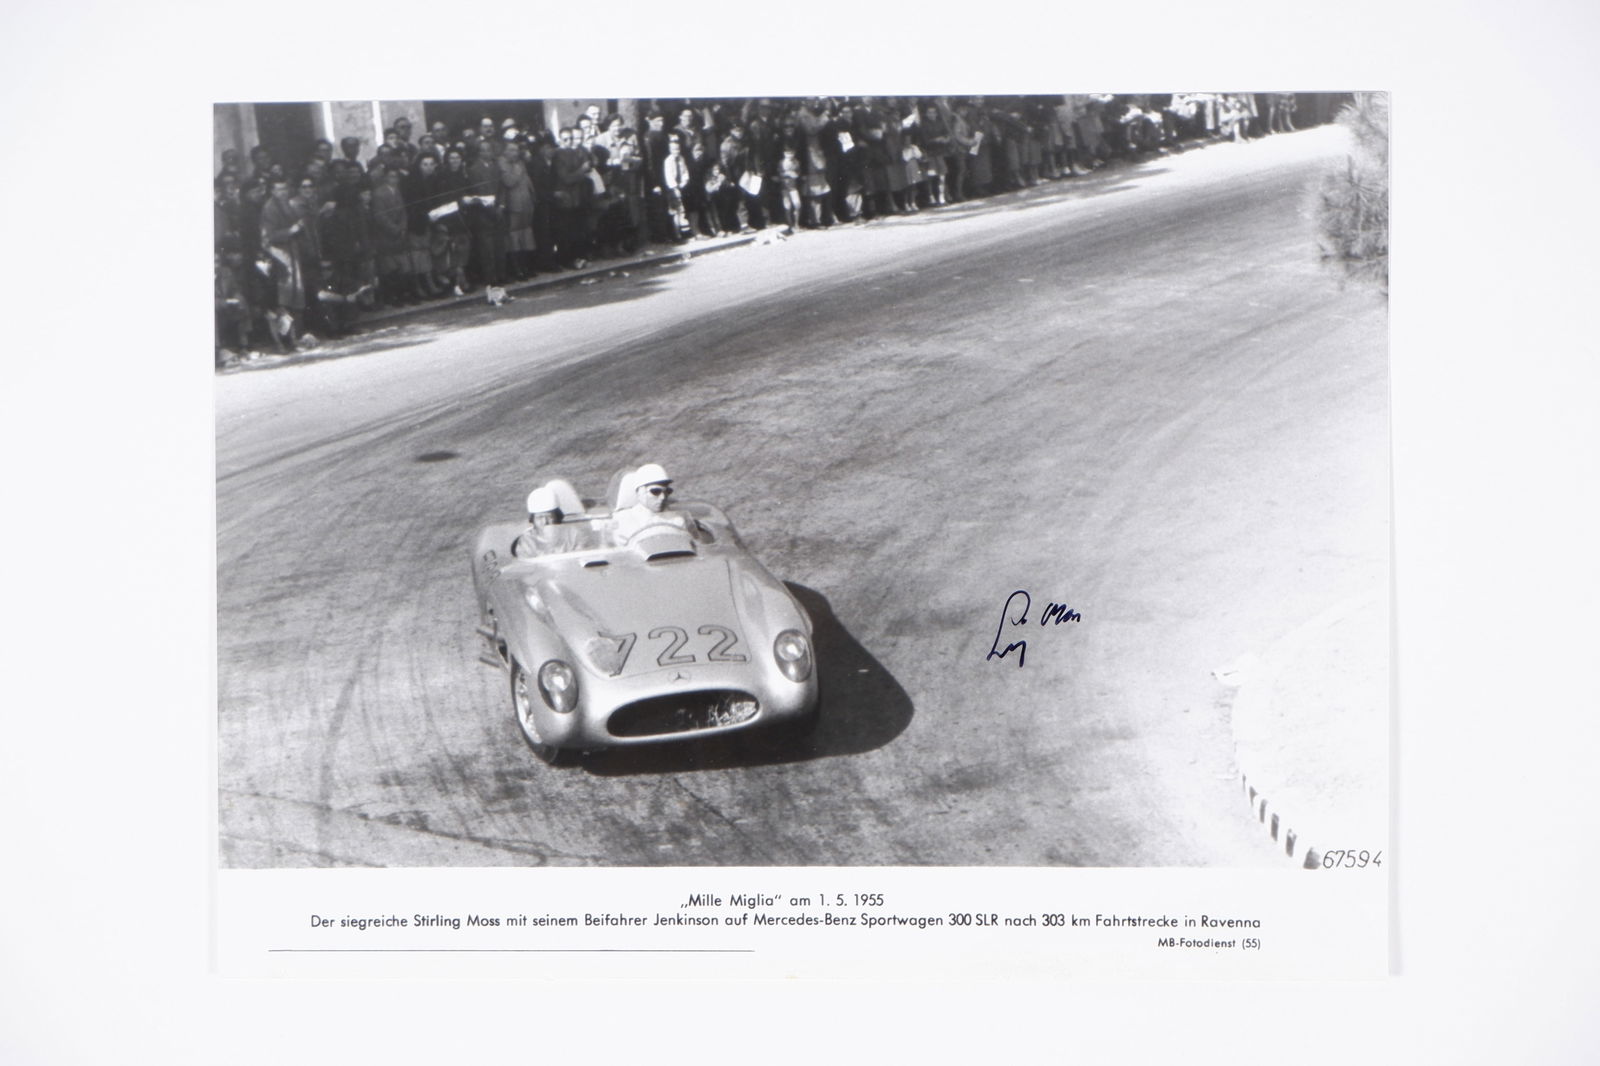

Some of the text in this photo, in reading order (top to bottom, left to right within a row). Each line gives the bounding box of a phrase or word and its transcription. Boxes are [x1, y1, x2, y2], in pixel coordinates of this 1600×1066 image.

[597, 624, 747, 678] 722
[1322, 849, 1383, 869] 67594
[789, 897, 811, 907] am
[819, 893, 830, 907] 1.
[836, 893, 848, 907] 5.
[854, 893, 884, 907] 1955
[310, 912, 1261, 931] Der siegreiche Stirling Moss mit seinem Beifahrer Jenkinson auf Mercedes-Benz Sportwagen 300 SLR nach 303 km Fahrtstrecke in Ravenna
[1157, 937, 1261, 951] MB-Fotodienst (55)
